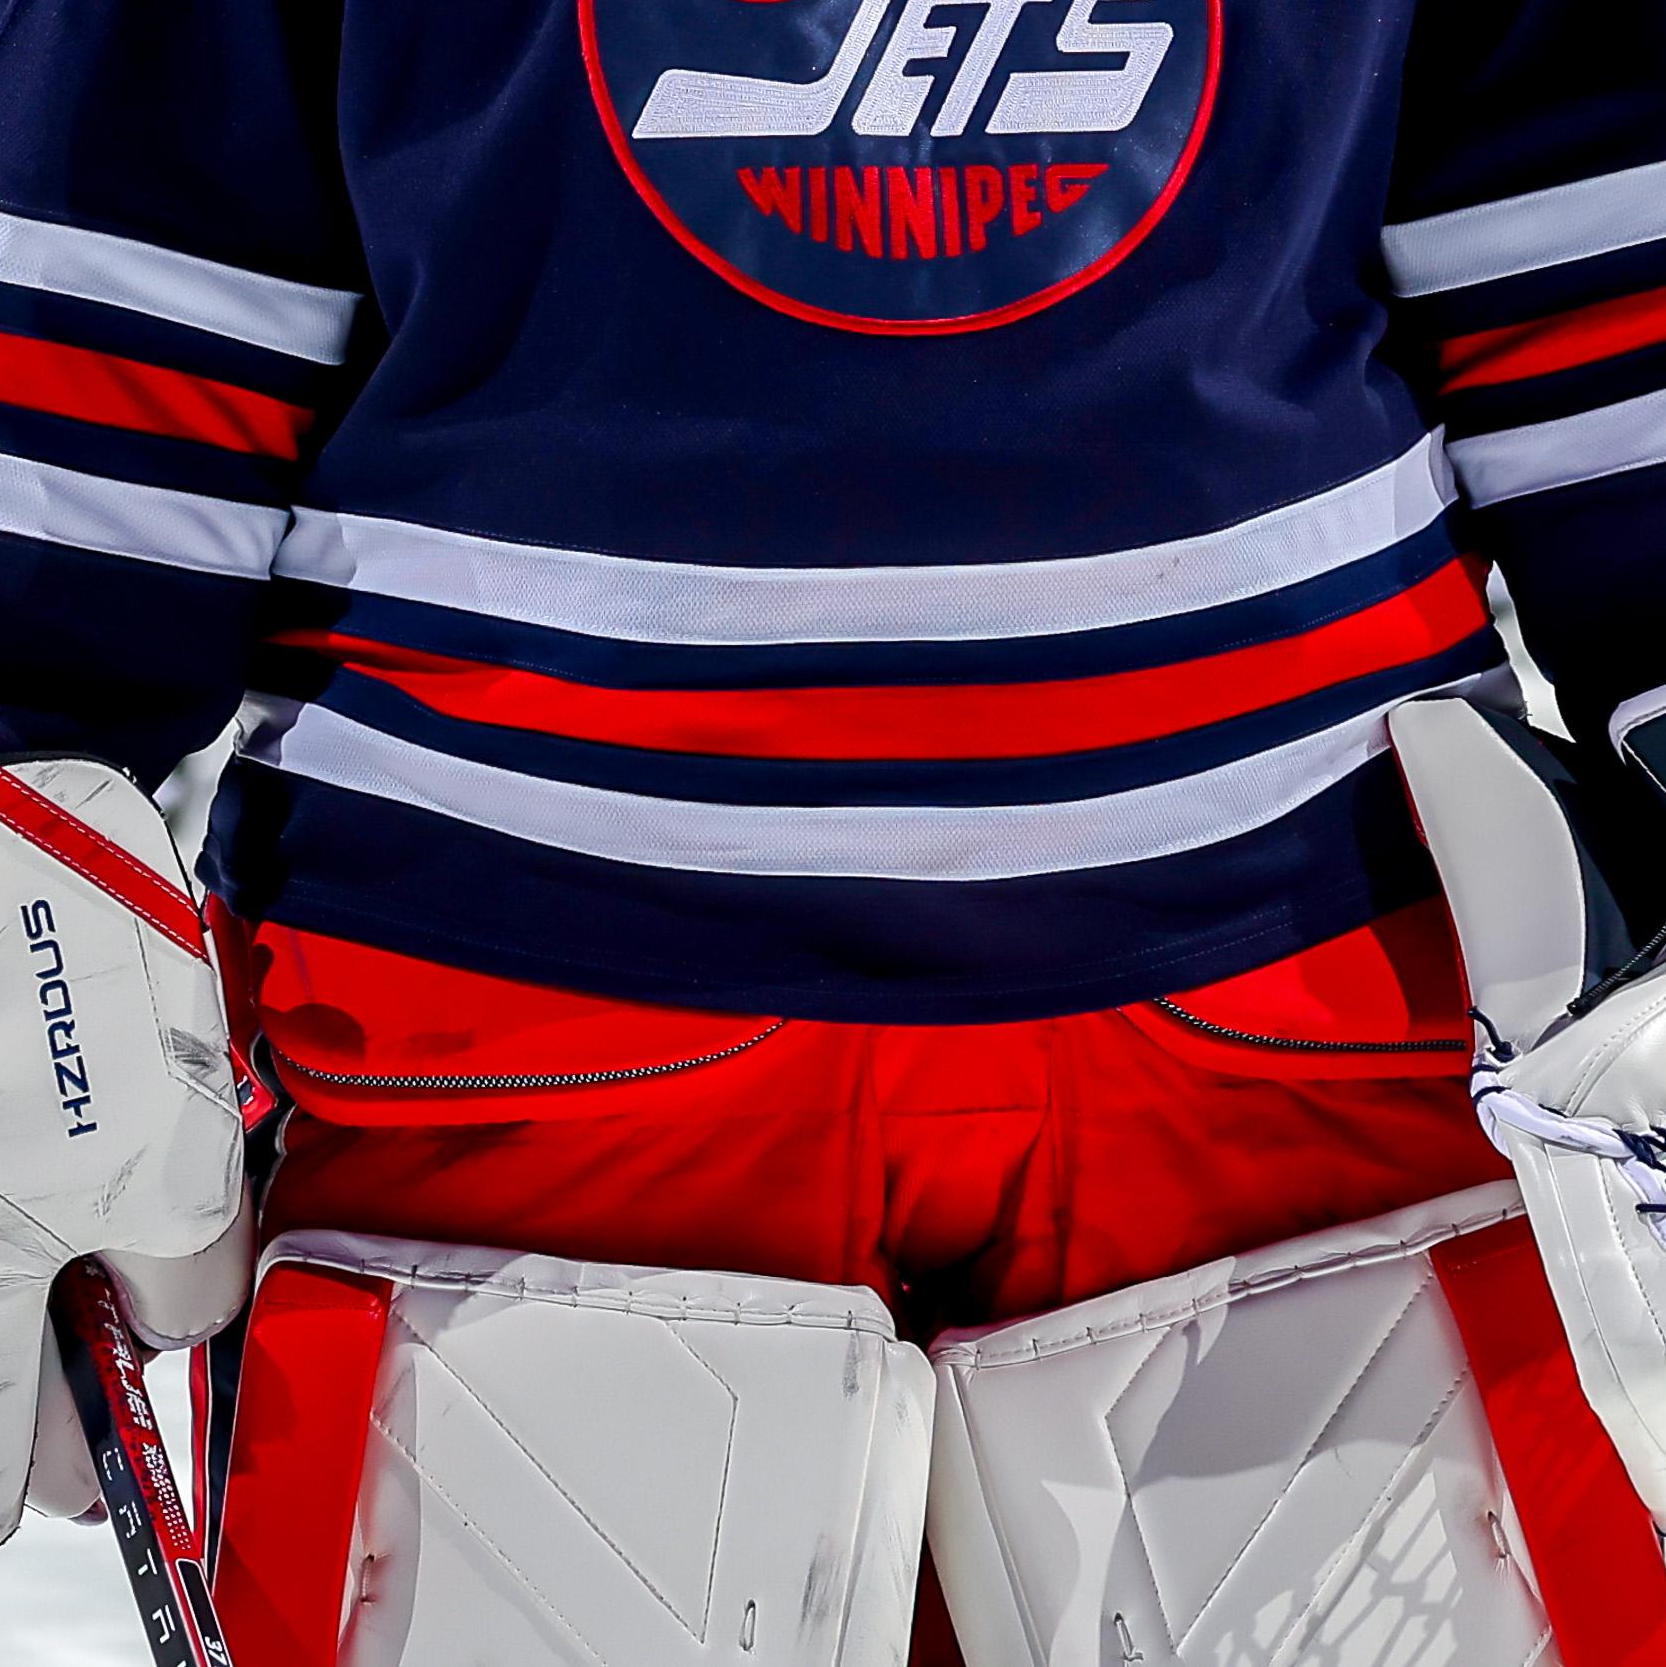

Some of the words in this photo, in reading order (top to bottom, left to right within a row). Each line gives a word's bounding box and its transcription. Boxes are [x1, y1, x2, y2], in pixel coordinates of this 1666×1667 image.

[736, 163, 1109, 260] WINNIPEG
[102, 1447, 188, 1667] CATA
[204, 1636, 228, 1666] 37
